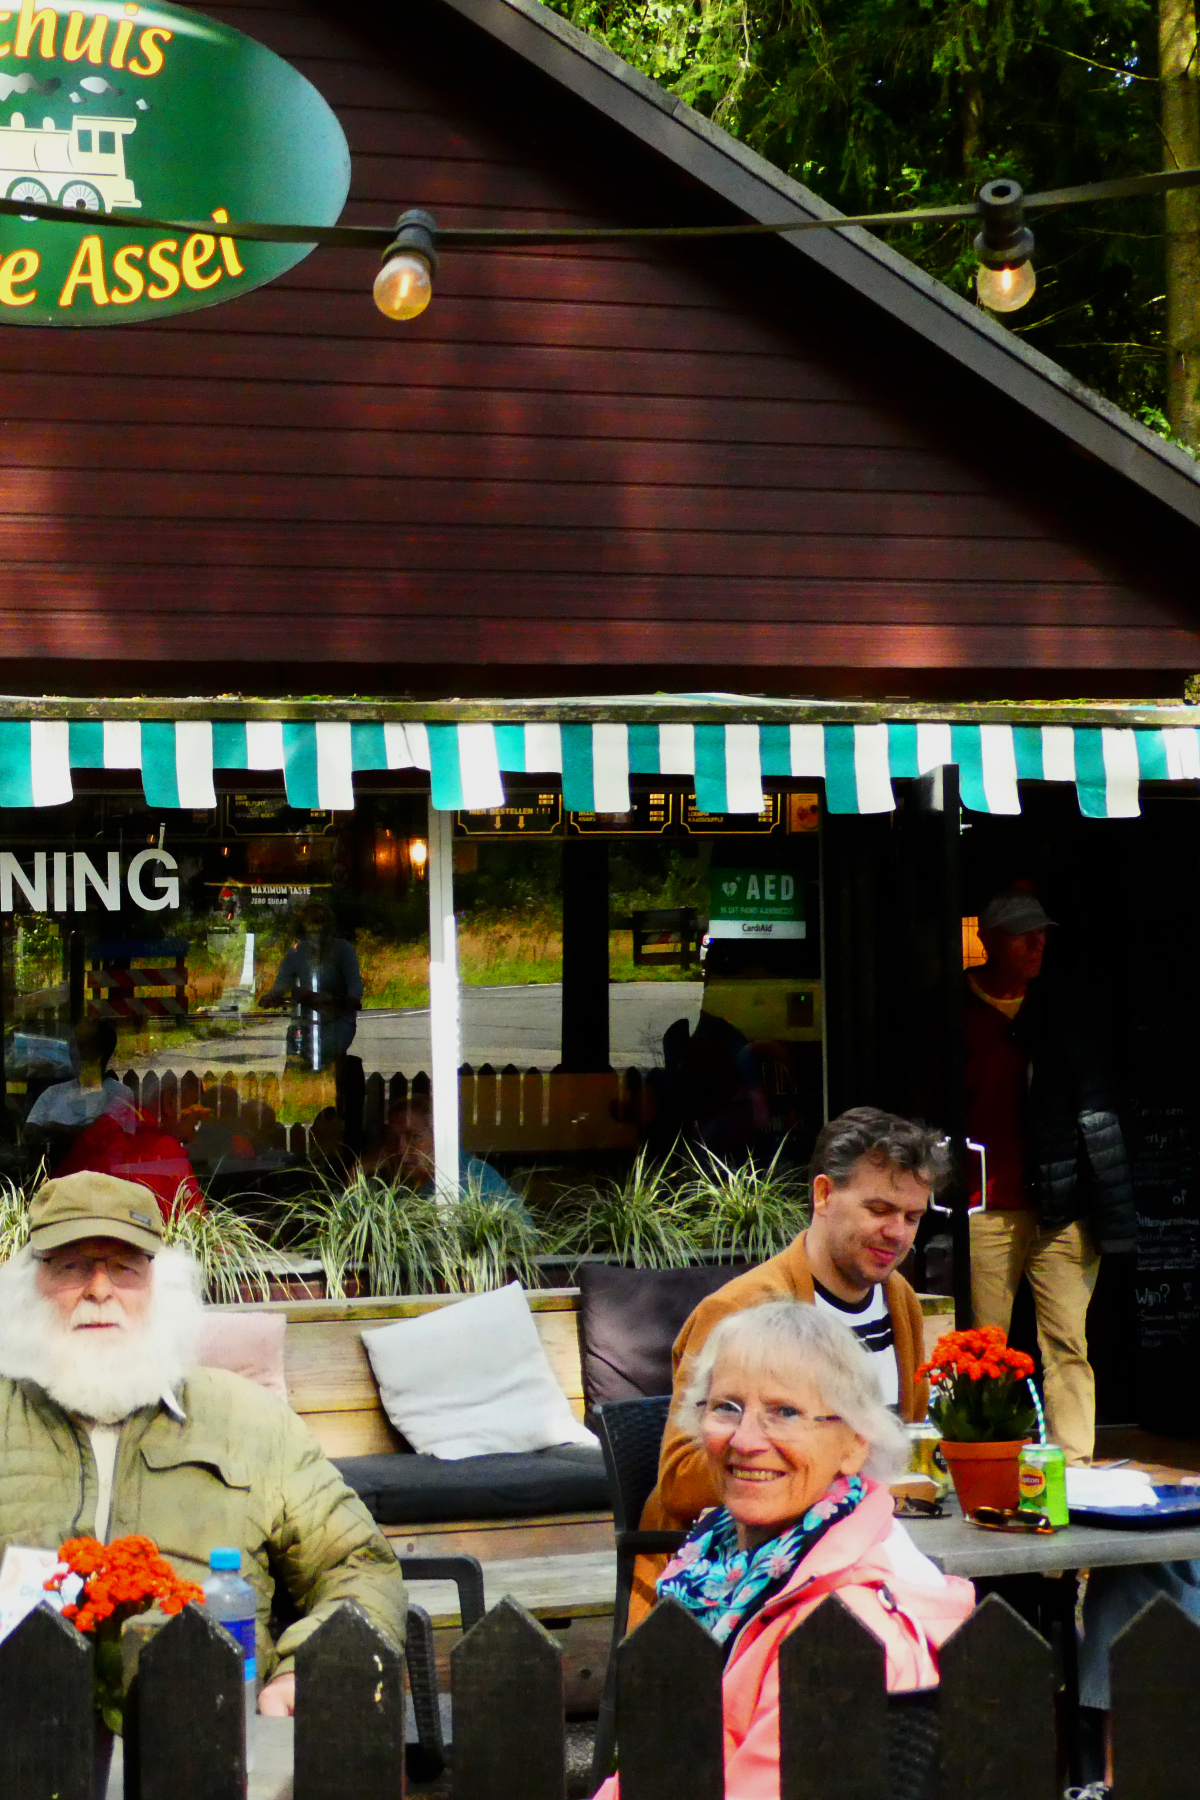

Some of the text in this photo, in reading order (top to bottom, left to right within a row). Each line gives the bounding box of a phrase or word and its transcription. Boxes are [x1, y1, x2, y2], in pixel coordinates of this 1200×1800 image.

[58, 207, 244, 308] Assel
[251, 886, 311, 895] MAXIMUM TASTE
[746, 874, 794, 901] AED
[1134, 1283, 1171, 1307] Wijn?
